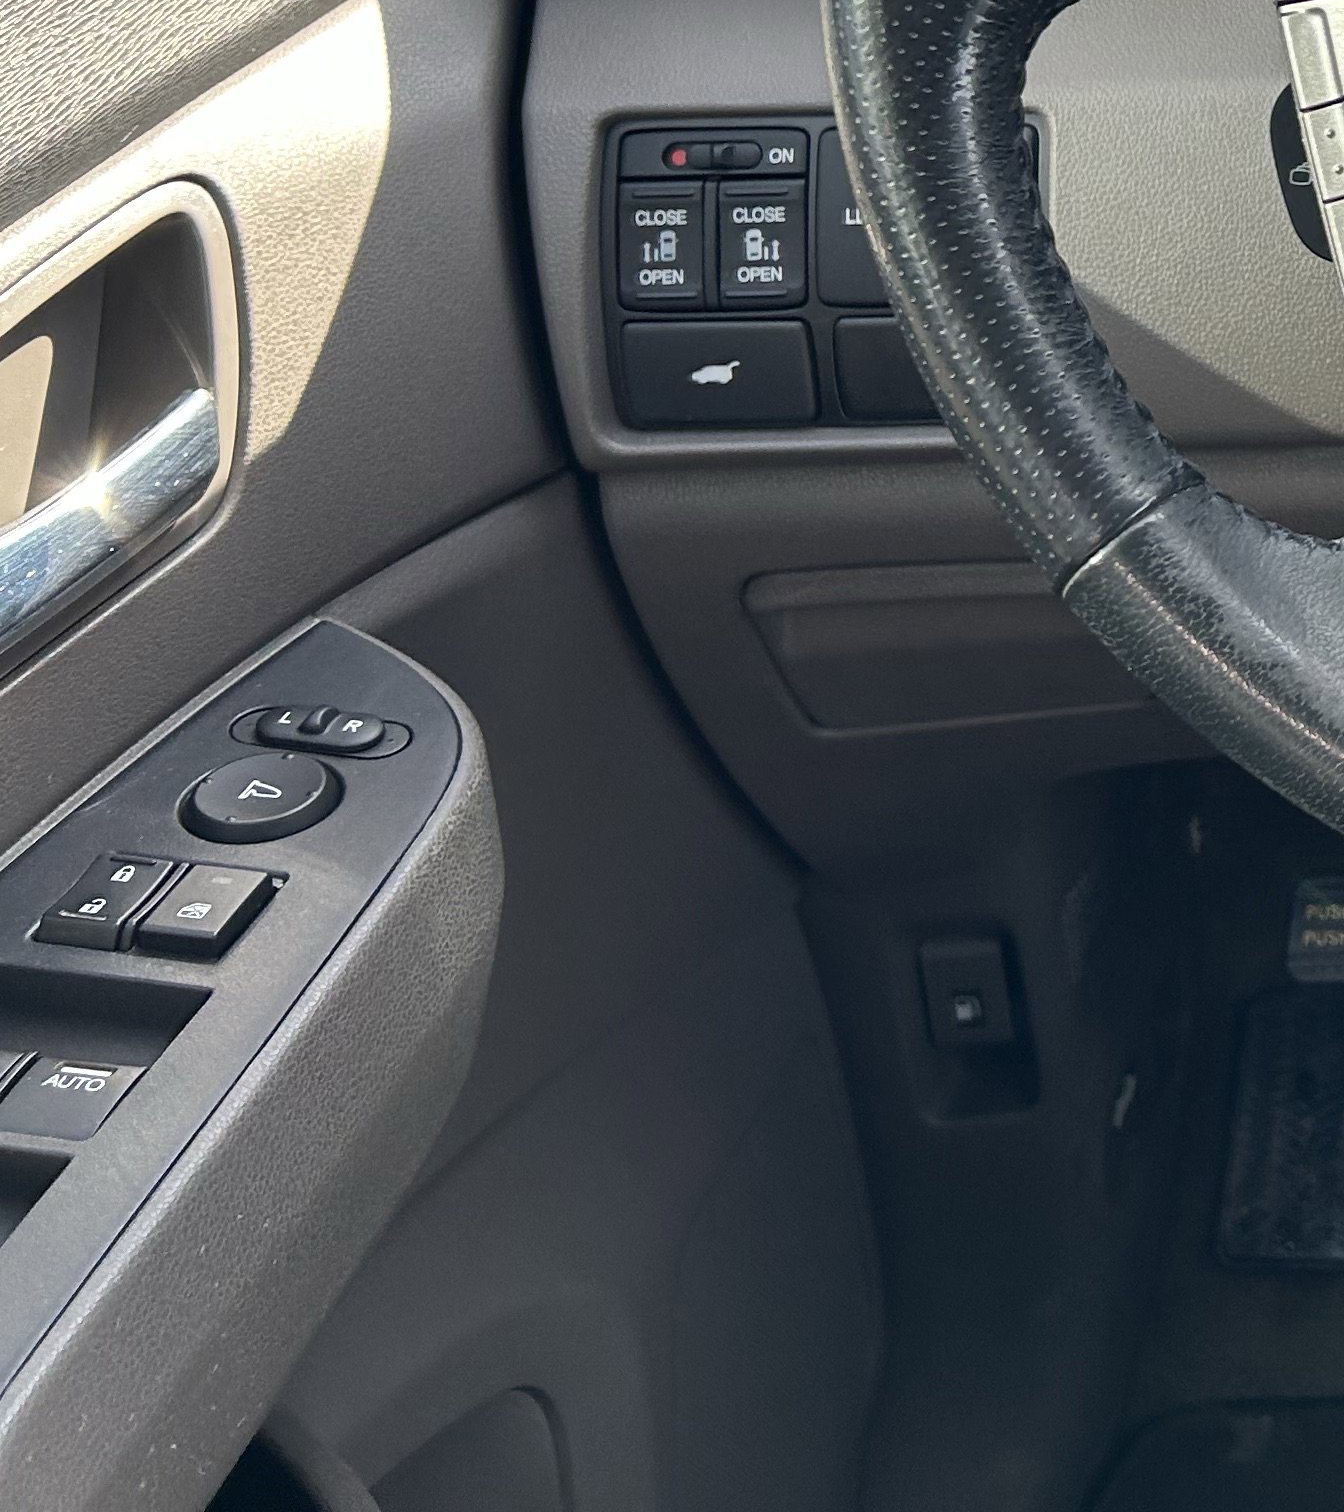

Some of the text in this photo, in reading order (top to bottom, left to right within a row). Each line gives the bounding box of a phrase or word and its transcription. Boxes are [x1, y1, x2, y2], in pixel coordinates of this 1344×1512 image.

[768, 147, 795, 165] ON
[634, 209, 688, 226] CLOSE
[732, 206, 787, 224] CLOSE
[638, 268, 685, 286] OPEN
[737, 266, 783, 283] OPEN
[278, 711, 291, 724] L
[342, 719, 364, 733] R
[41, 1073, 107, 1092] AUTO
